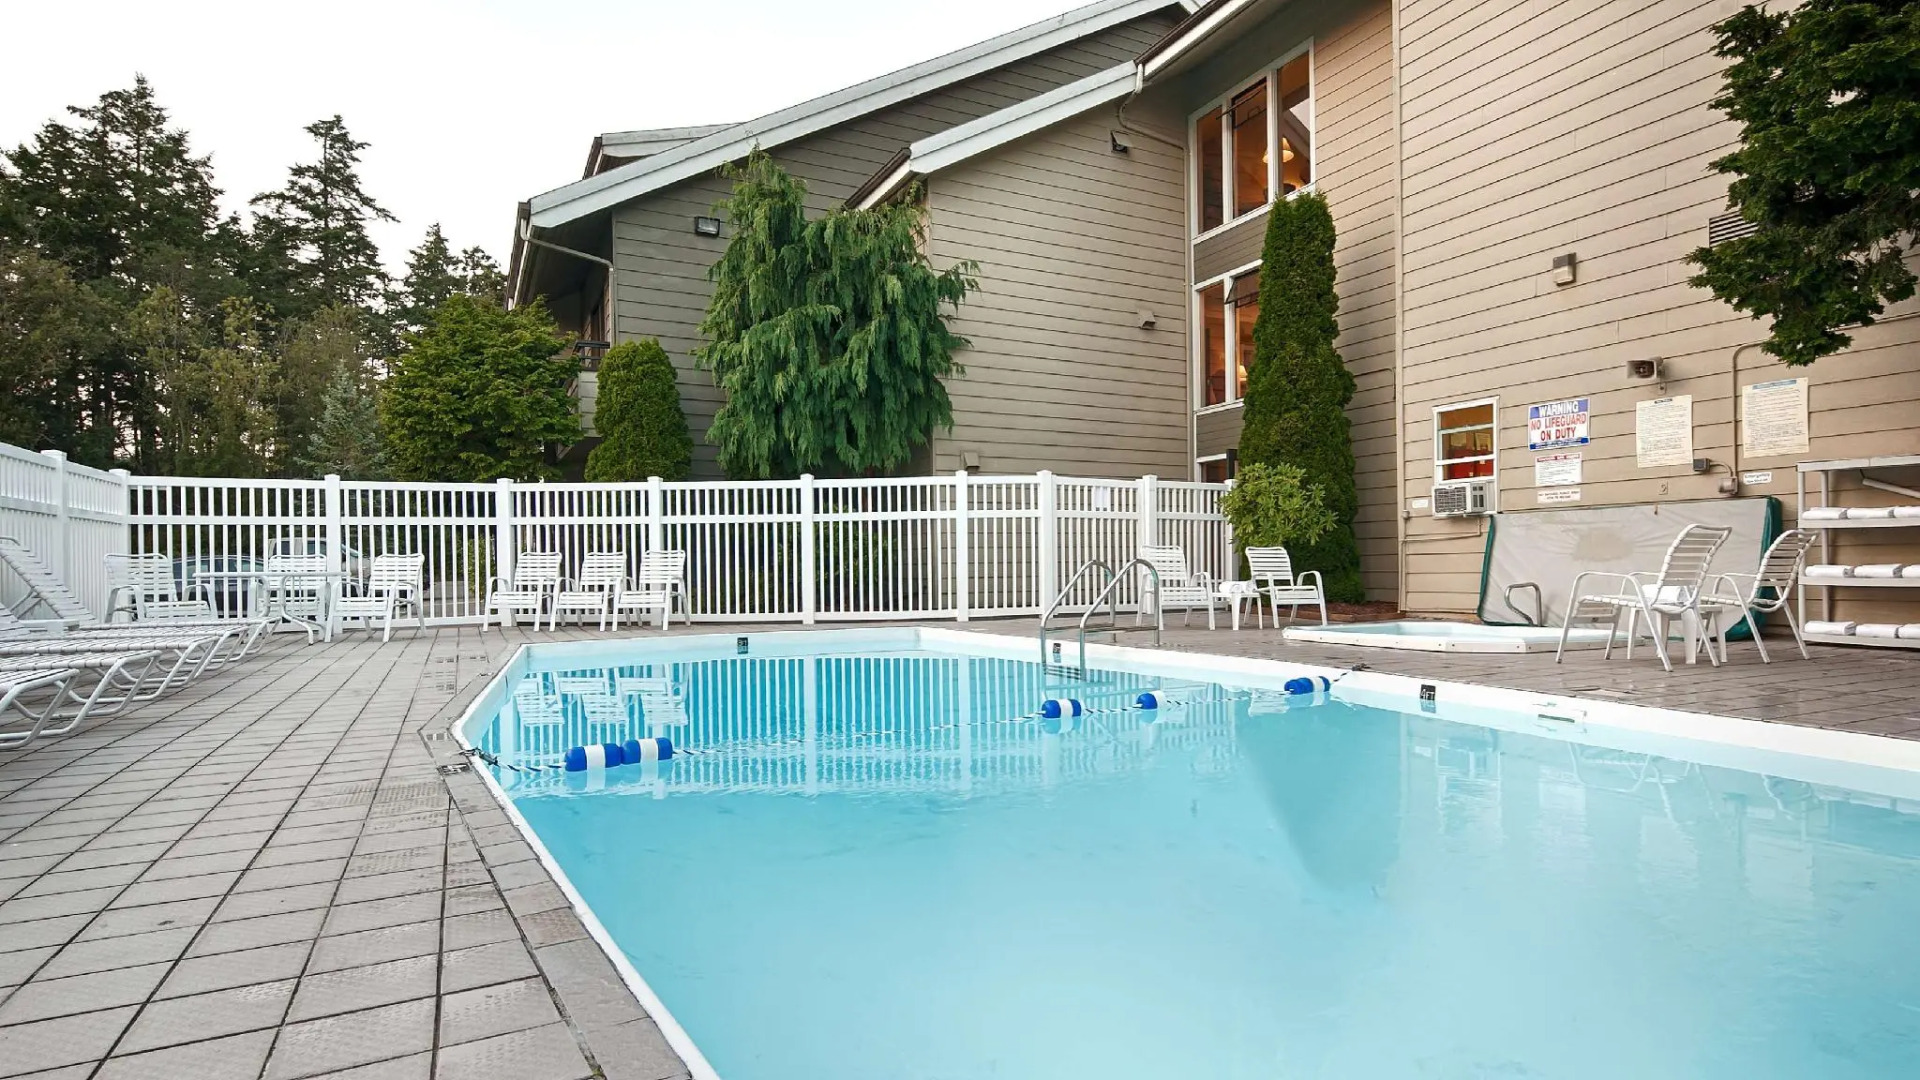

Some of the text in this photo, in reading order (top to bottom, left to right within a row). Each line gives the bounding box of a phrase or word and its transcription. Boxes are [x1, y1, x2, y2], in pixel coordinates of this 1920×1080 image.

[1539, 400, 1579, 417] WARNING
[1530, 413, 1587, 430] NO LIFEGUARD
[1541, 427, 1576, 441] ON DUTY
